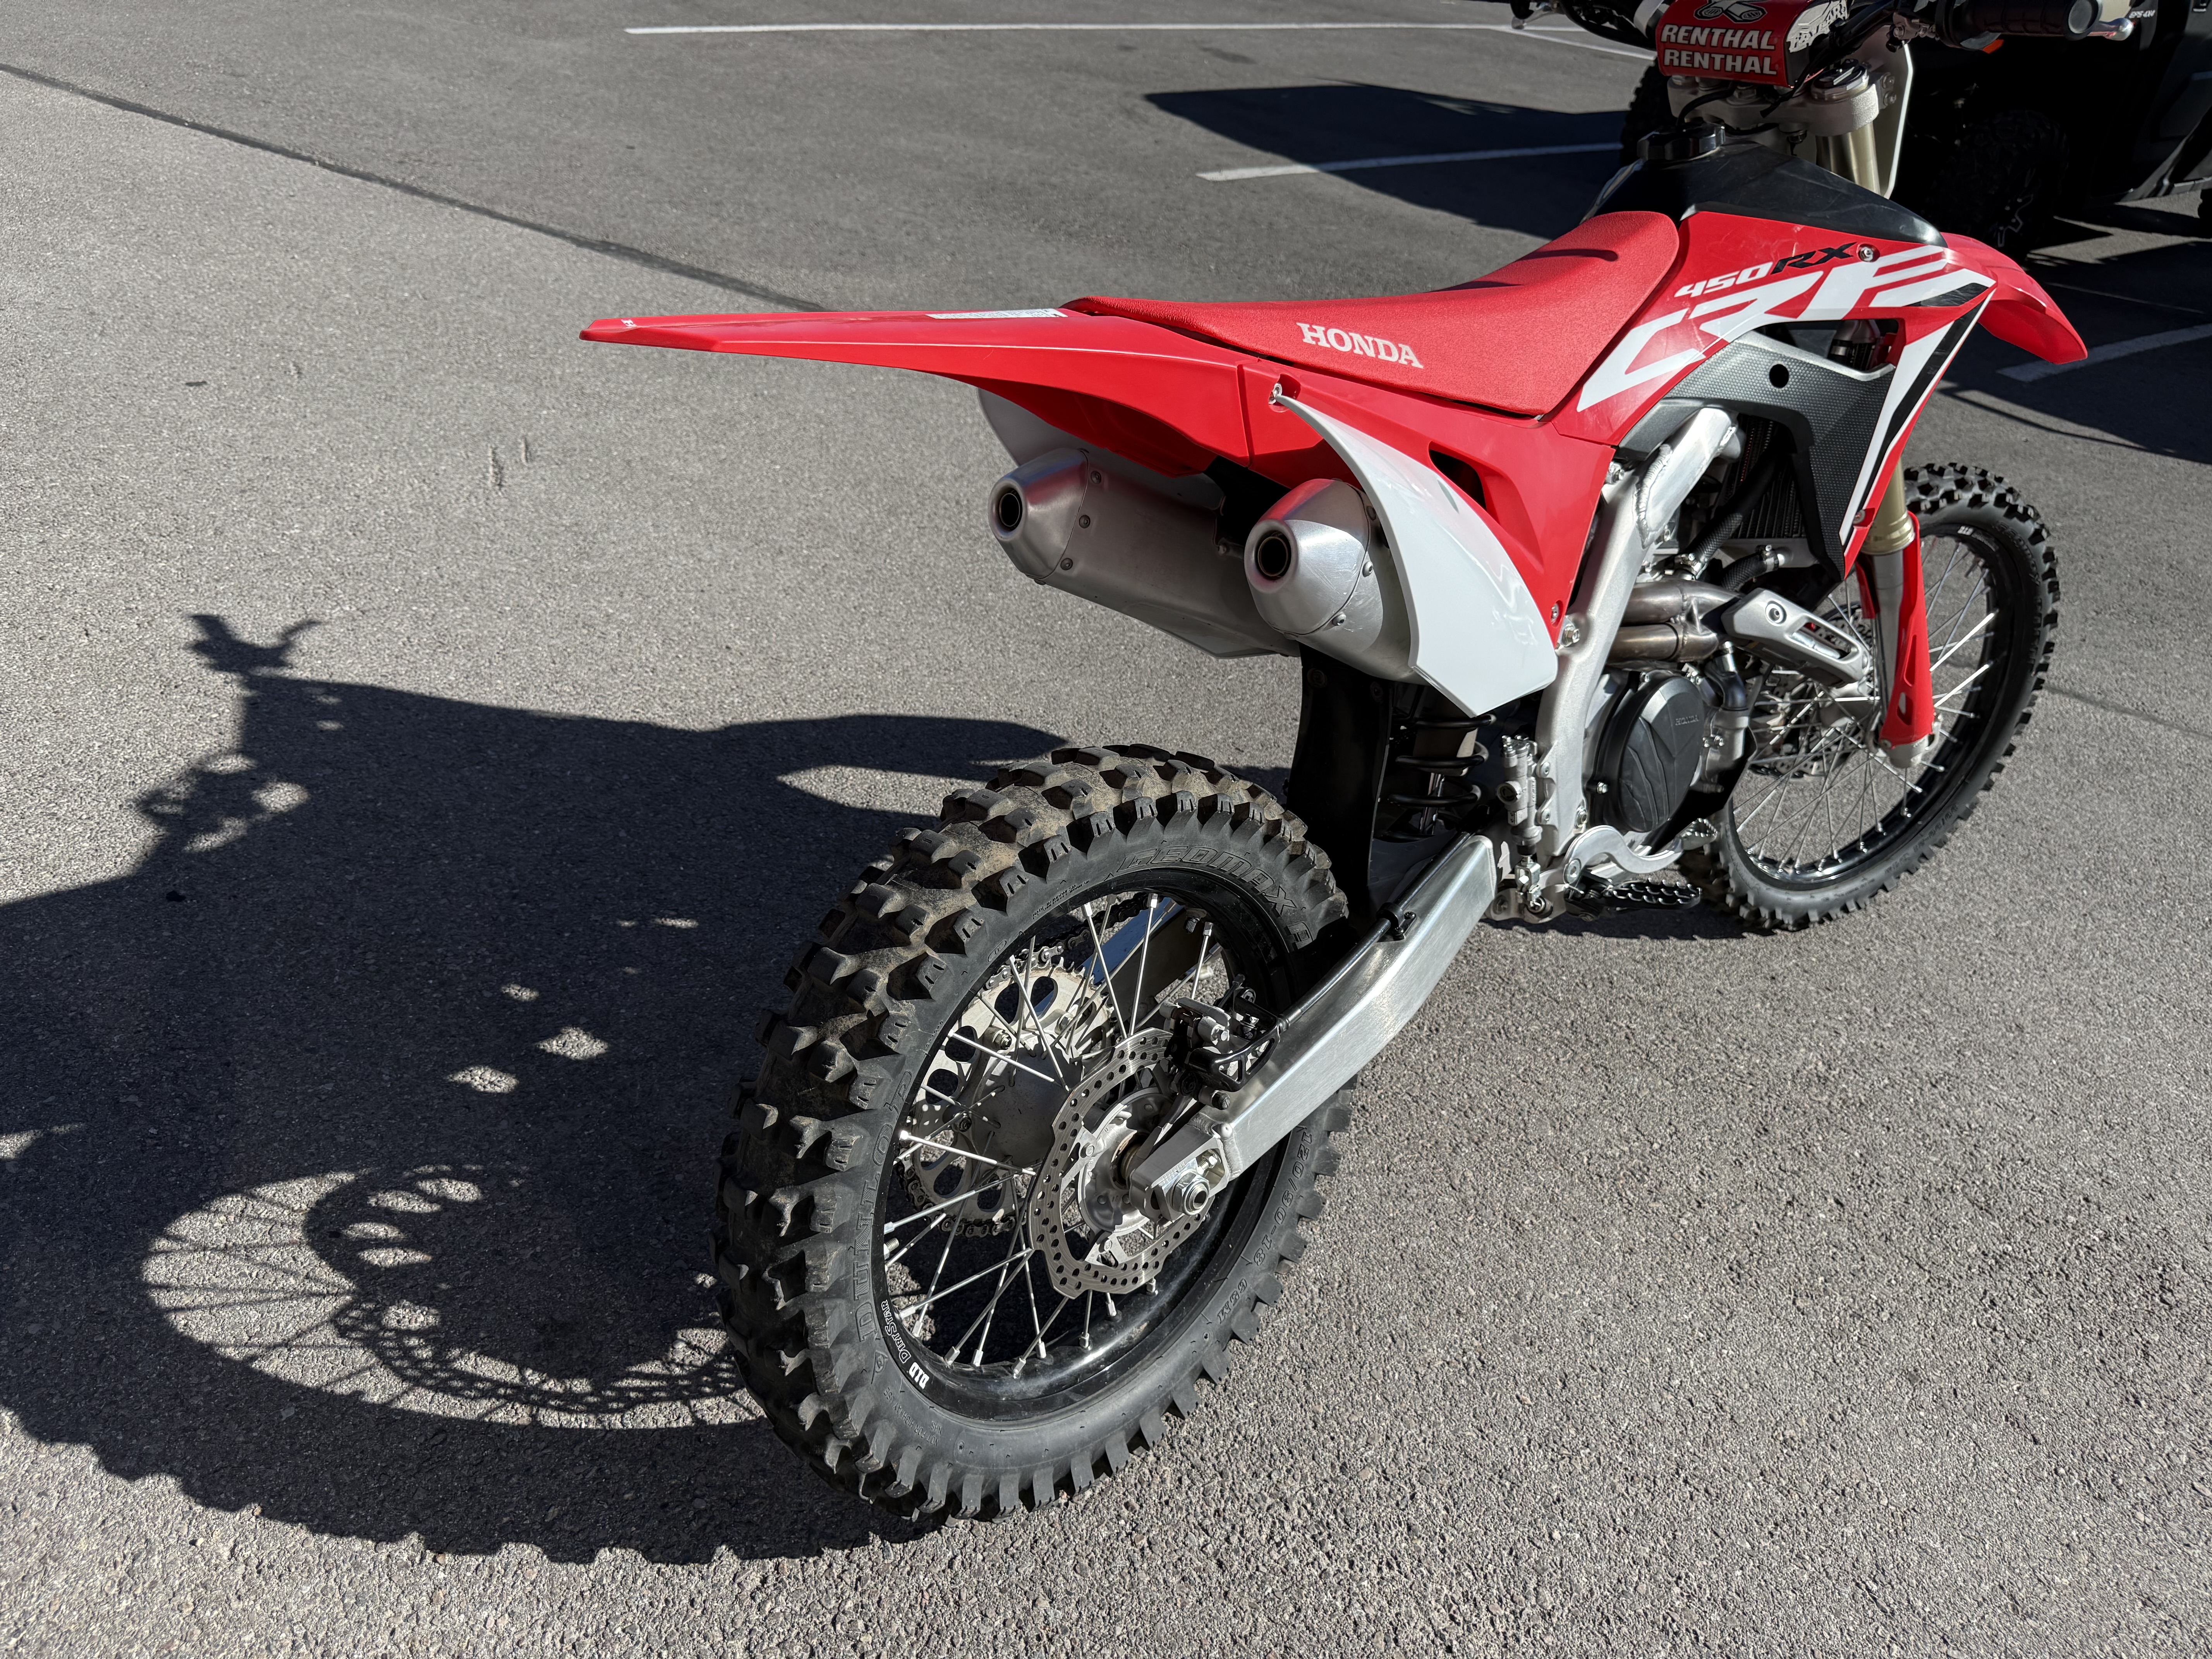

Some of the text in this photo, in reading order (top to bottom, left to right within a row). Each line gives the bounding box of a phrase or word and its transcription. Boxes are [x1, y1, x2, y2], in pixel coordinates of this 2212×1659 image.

[1661, 24, 1775, 50] RENTHAL
[1664, 49, 1777, 75] RENTHAL
[1296, 322, 1424, 368] HONDA
[1577, 245, 1996, 412] CRF
[1116, 846, 1297, 916] GEOMAX
[854, 1071, 912, 1342] DUNLOP
[1253, 1131, 1312, 1266] 120/90-18
[883, 1387, 940, 1446] NOT FOR HIGHWAY USE
[931, 1421, 943, 1435] NHS
